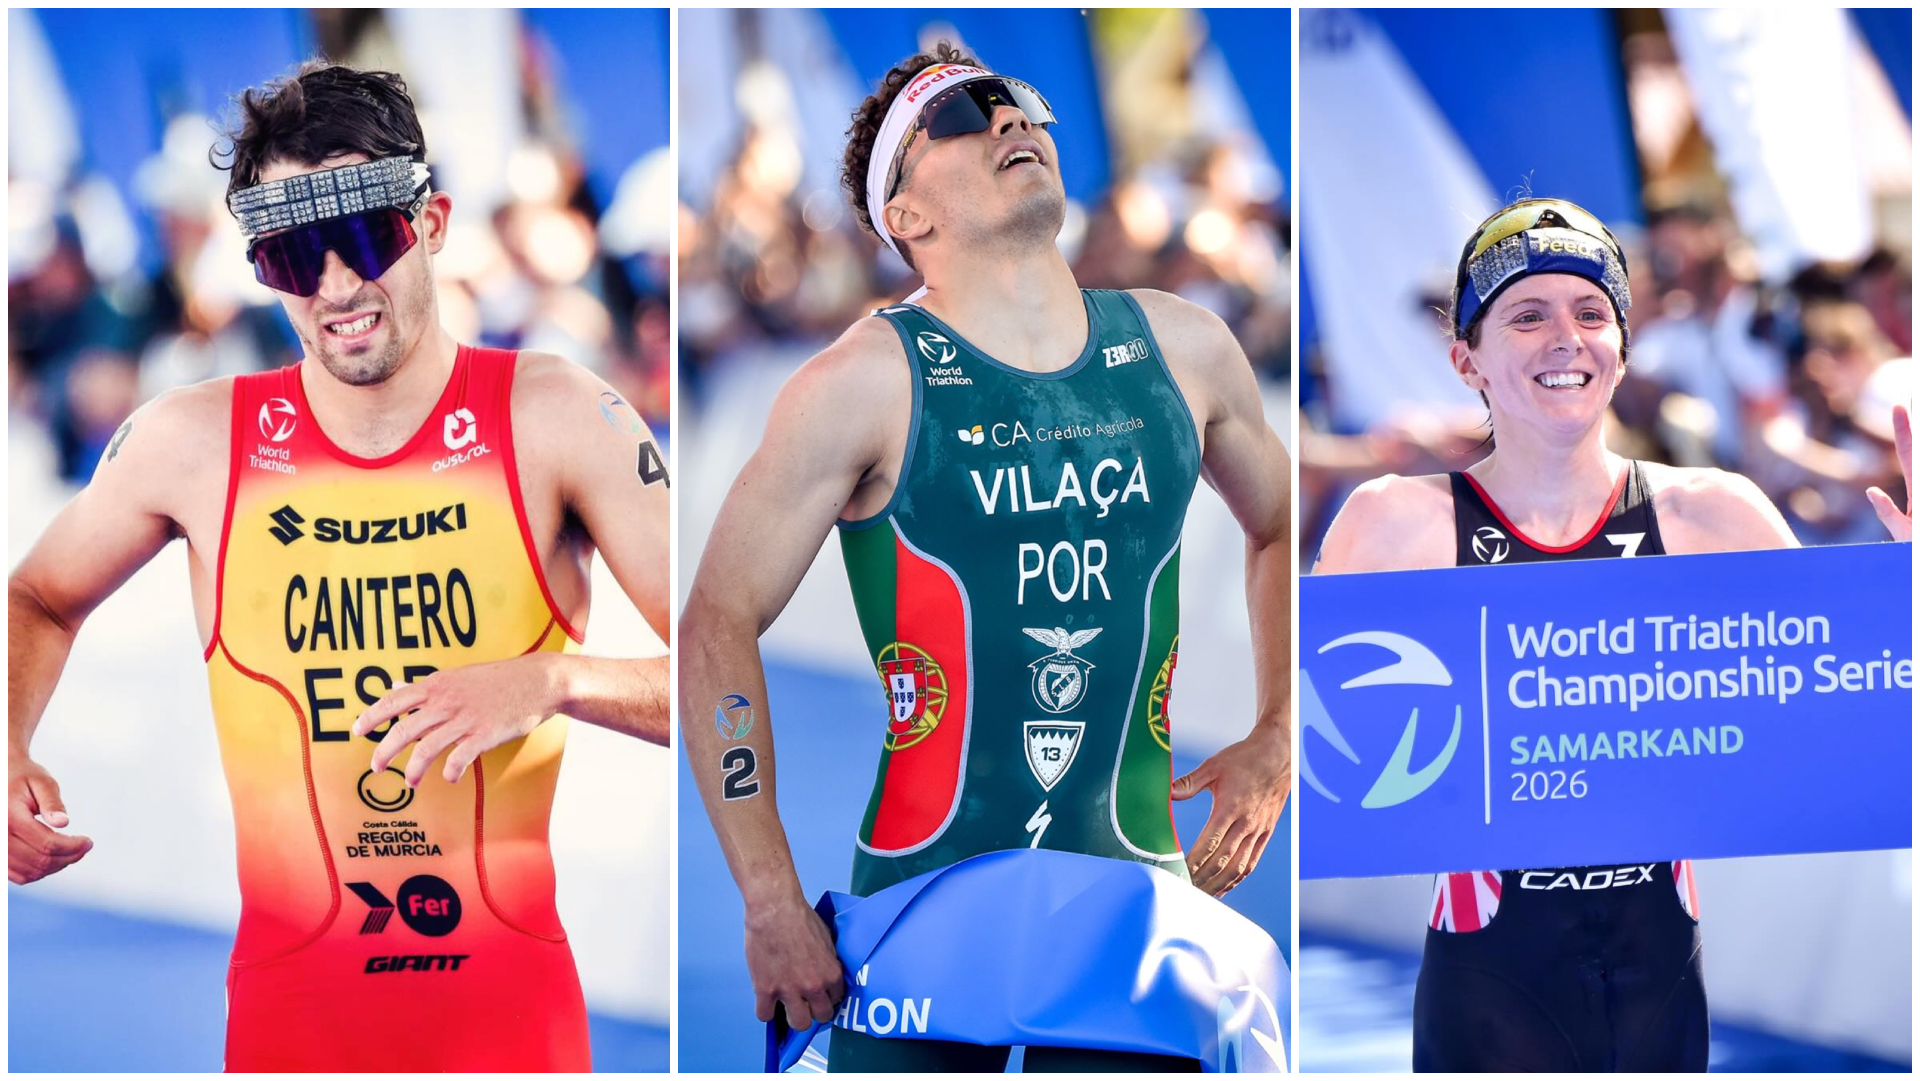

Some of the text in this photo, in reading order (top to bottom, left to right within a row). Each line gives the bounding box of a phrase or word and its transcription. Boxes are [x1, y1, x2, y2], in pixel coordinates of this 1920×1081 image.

[906, 73, 946, 104] Red
[925, 376, 973, 387] Triathlon
[929, 367, 963, 377] World
[991, 416, 1145, 447] CA Crédito Agrícola
[249, 454, 296, 475] Triathlon
[257, 443, 290, 461] World
[431, 443, 492, 473] austral
[636, 439, 670, 489] 4
[969, 456, 1151, 518] VILAÇA
[313, 502, 468, 545] SUZUKI
[1017, 538, 1112, 606] POR
[284, 567, 477, 654] CANTERO
[1507, 611, 1830, 660] World Triathlon
[1507, 648, 1912, 712] Championship Serie
[1040, 746, 1062, 762] 13
[1510, 725, 1744, 766] SAMARKAND
[721, 745, 761, 801] 2
[1510, 769, 1589, 802] 2026
[357, 829, 426, 845] REGIÓN
[362, 820, 418, 829] Costa Cálida
[346, 844, 443, 858] DE MURCIA
[1519, 863, 1656, 891] CADEX
[407, 894, 450, 917] Fer
[363, 954, 472, 974] GIANT
